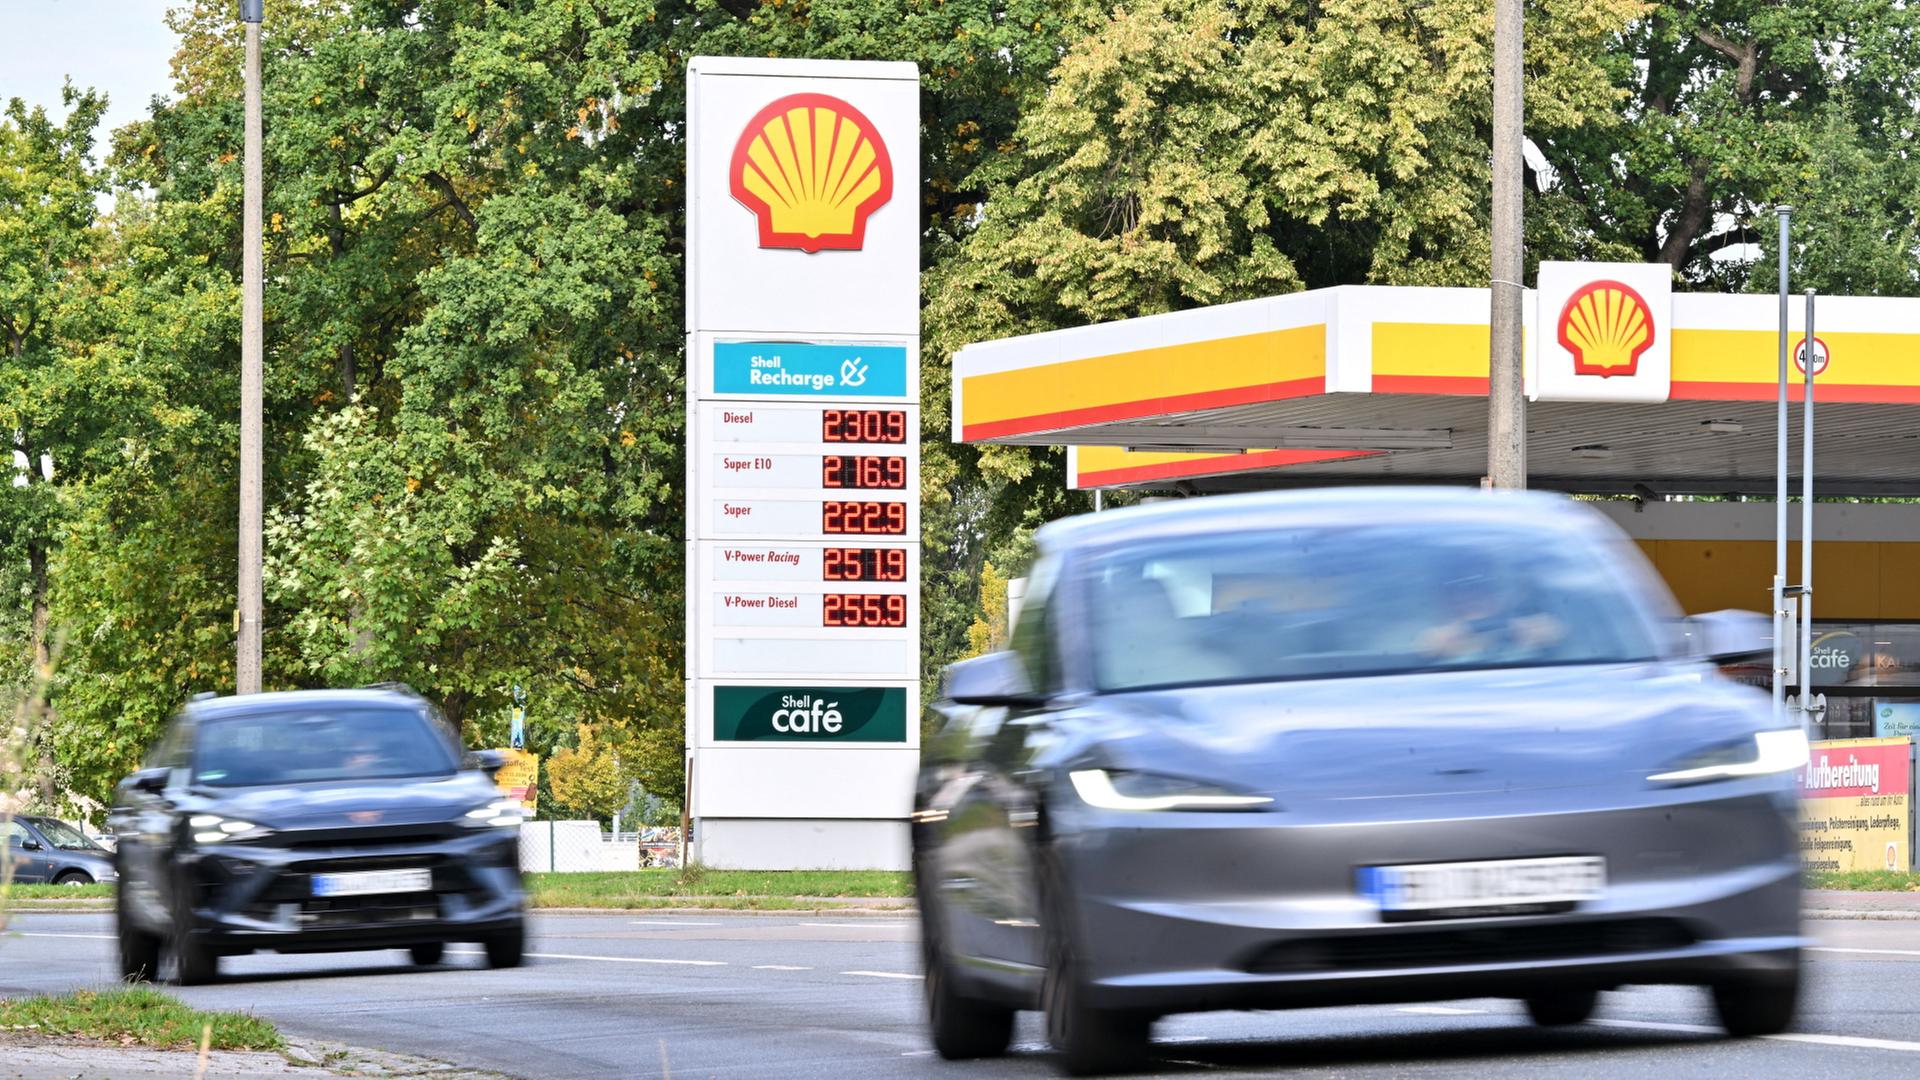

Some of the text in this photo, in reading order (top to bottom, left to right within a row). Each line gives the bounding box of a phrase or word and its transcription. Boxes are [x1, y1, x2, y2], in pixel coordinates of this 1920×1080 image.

[751, 356, 781, 369] Shell
[750, 369, 835, 390] Recharge
[723, 412, 753, 424] Diesel
[824, 411, 905, 441] 230.9
[724, 458, 772, 472] Super E10
[824, 456, 905, 487] 216.9
[724, 503, 752, 518] Super
[824, 502, 905, 533] 222.9
[724, 550, 800, 566] V-Power Racing
[824, 549, 905, 580] 251.9
[724, 596, 798, 609] V-Power Diesel
[824, 595, 905, 626] 255.9
[1810, 649, 1850, 669] café
[1813, 646, 1831, 655] Shell
[781, 695, 811, 708] Shell
[771, 699, 843, 733] café
[1805, 753, 1880, 794] Aufbereitung
